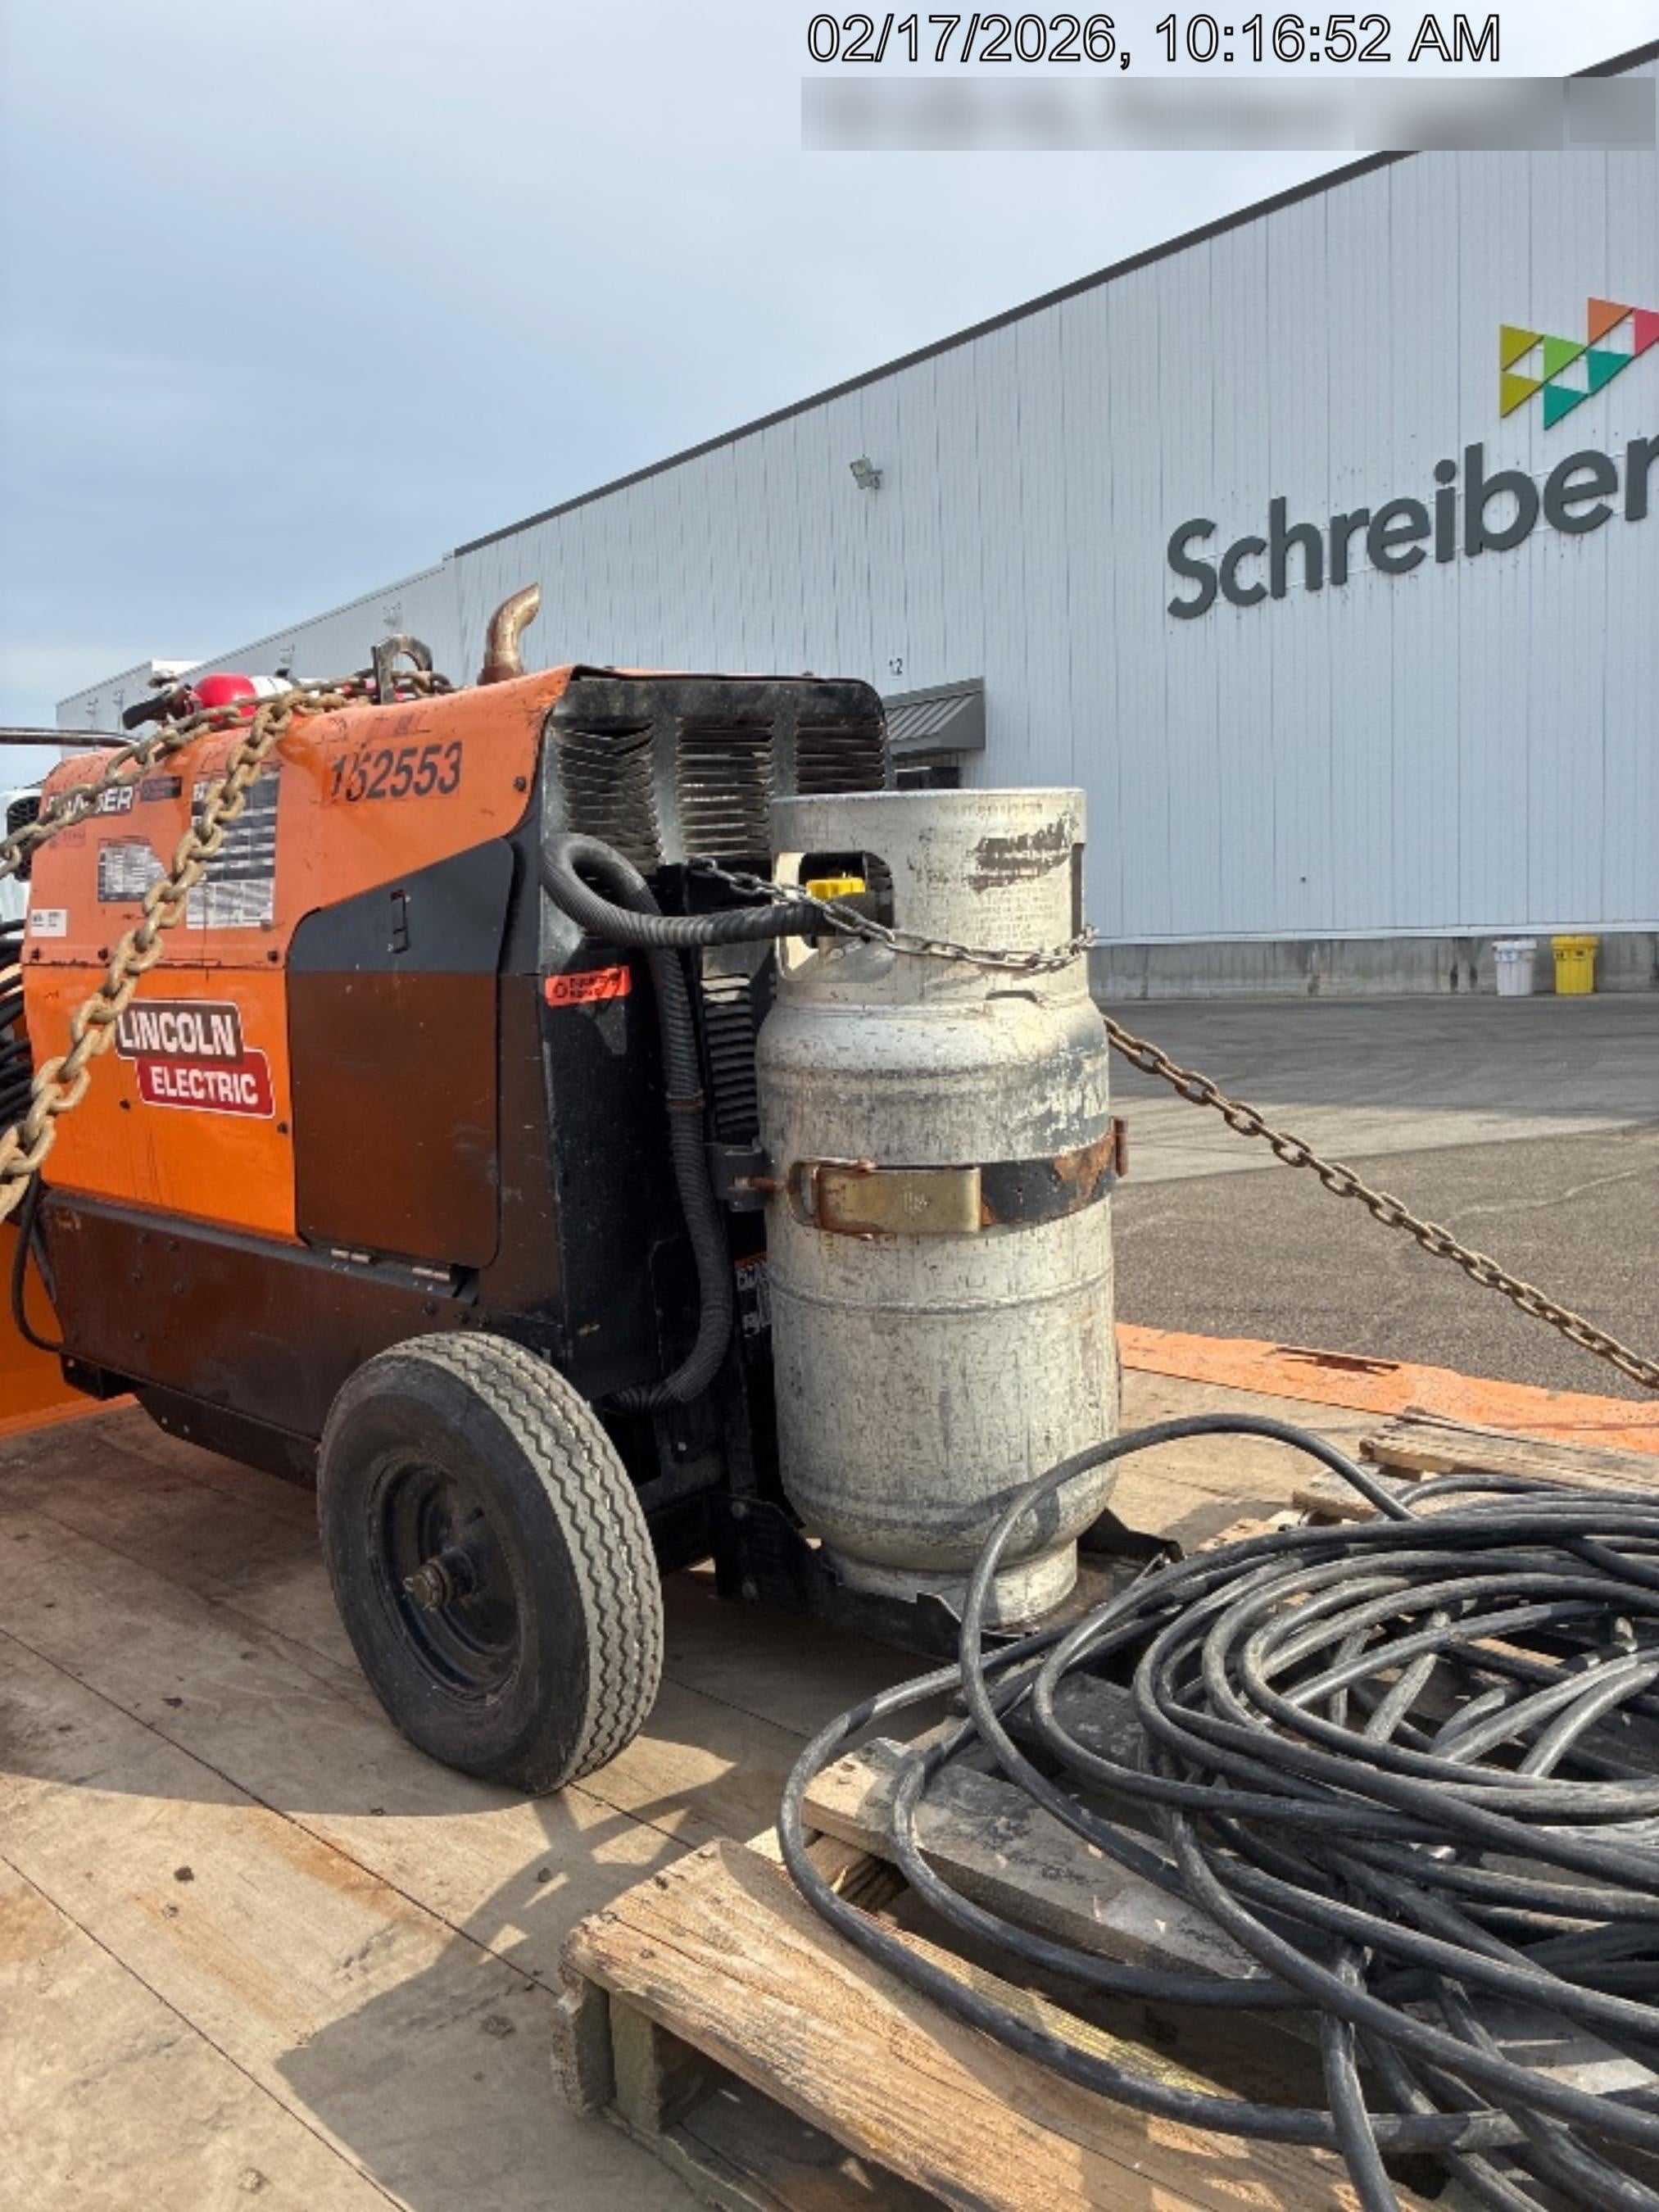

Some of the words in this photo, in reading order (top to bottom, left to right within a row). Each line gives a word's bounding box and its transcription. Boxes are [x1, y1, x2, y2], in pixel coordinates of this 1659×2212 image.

[1167, 437, 1659, 620] Schreiber
[118, 1010, 237, 1058] LINCOLN
[151, 1066, 258, 1105] ELECTRIC
